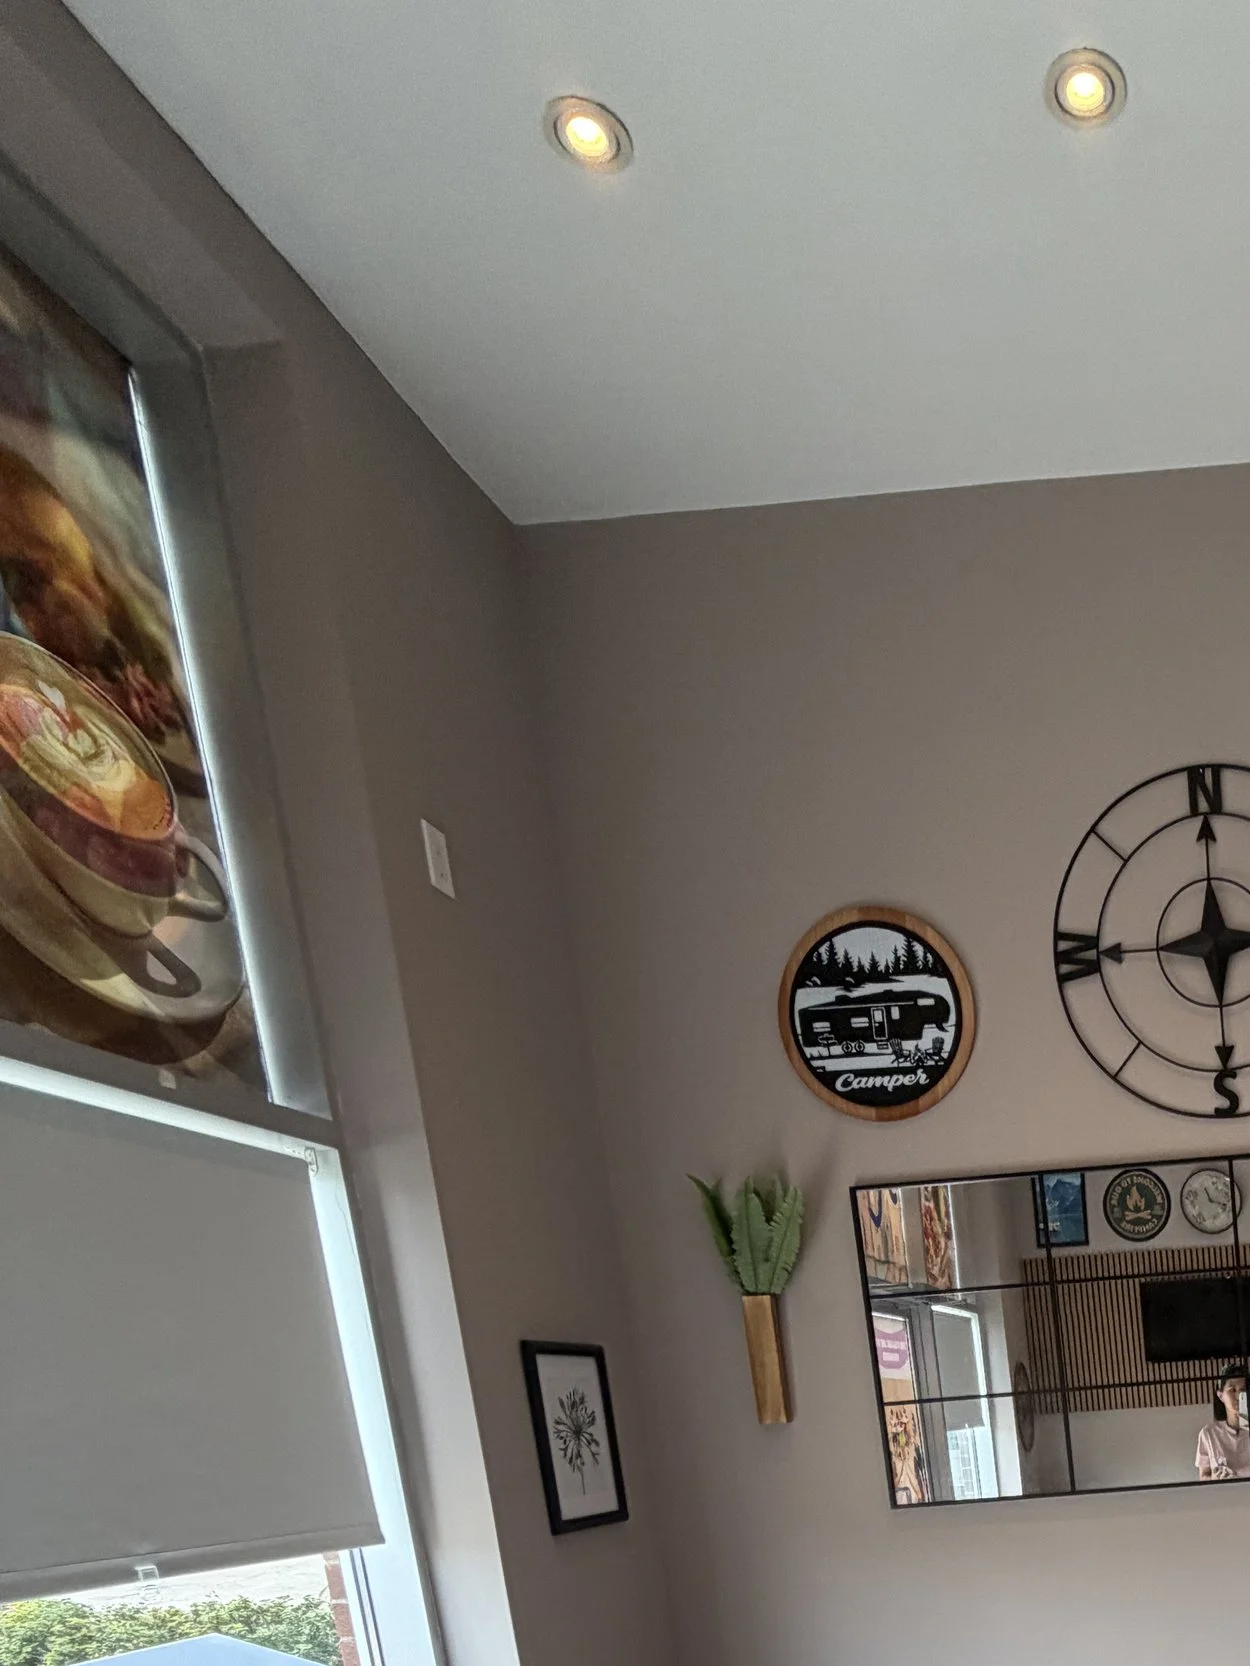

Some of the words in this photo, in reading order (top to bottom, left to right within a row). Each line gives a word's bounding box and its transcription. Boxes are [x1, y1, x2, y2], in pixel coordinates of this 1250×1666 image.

[1188, 766, 1222, 814] N
[834, 1068, 930, 1092] Camper
[1213, 1070, 1239, 1116] S
